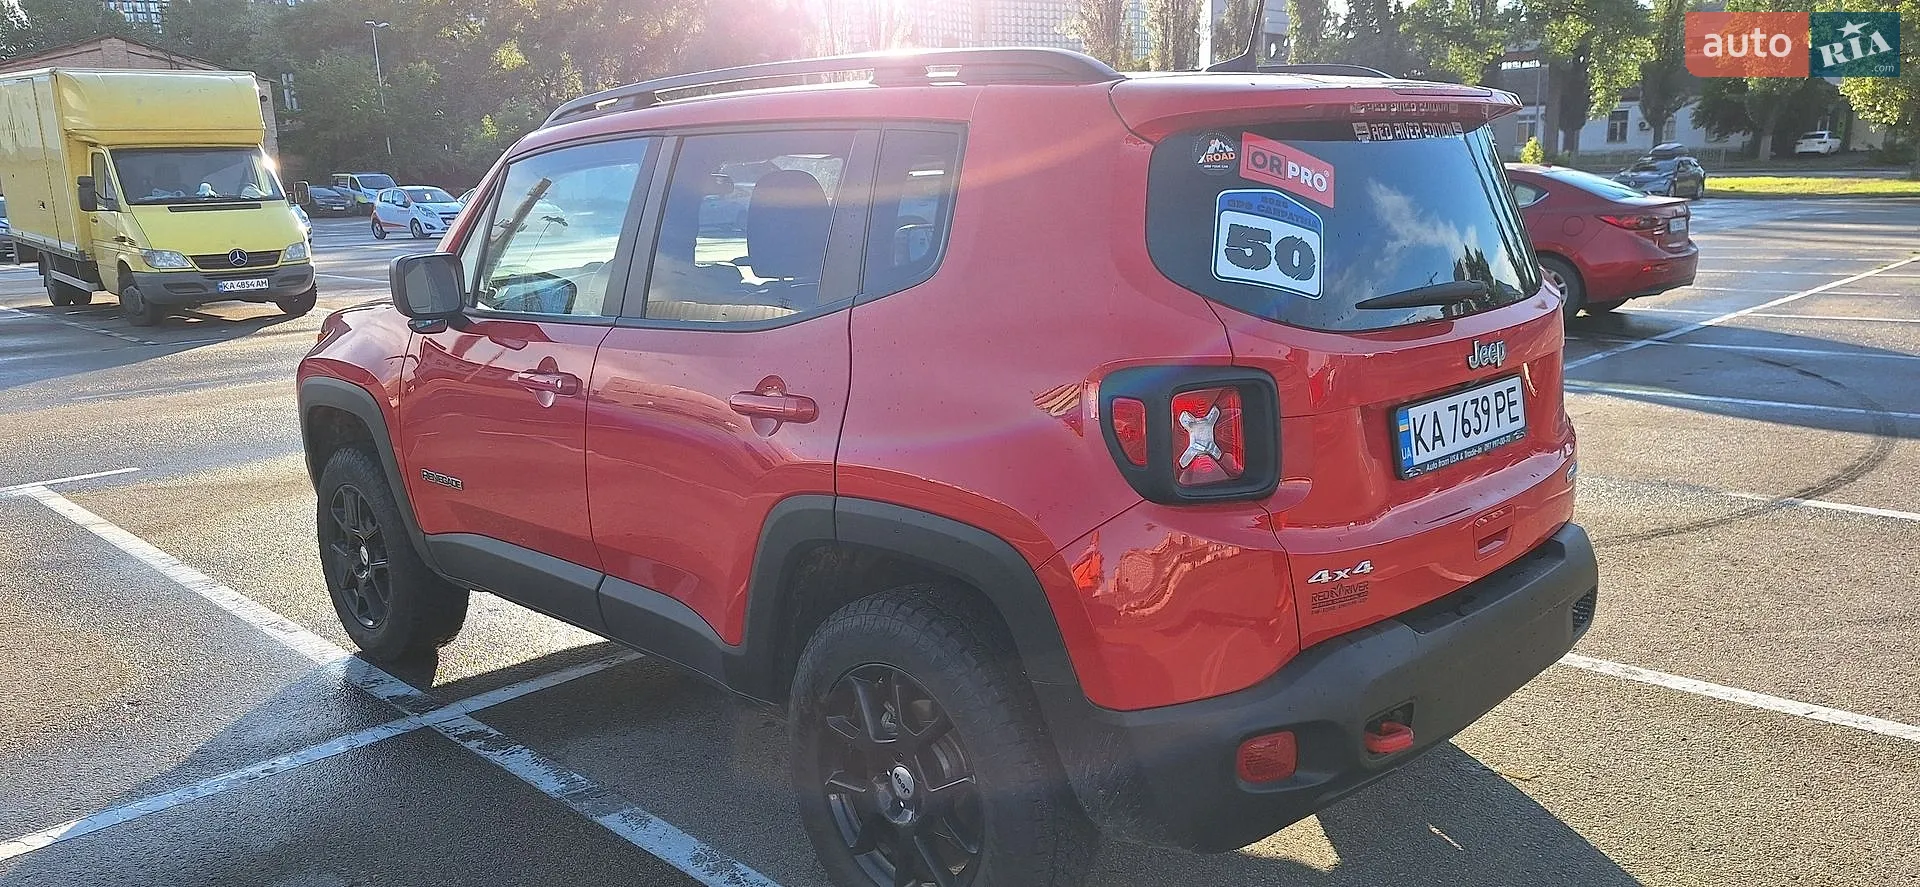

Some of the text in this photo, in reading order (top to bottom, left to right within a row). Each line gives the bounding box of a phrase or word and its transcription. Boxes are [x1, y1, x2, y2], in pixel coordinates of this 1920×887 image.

[1371, 122, 1455, 141] RED RIVER EDITION
[1224, 223, 1316, 281] 50
[1468, 339, 1506, 369] Jeep
[1412, 386, 1520, 456] KA 7639 PE
[1401, 447, 1412, 460] UA
[1307, 560, 1374, 584] 4x4
[1311, 590, 1330, 603] RED
[1344, 580, 1369, 596] RIVER
